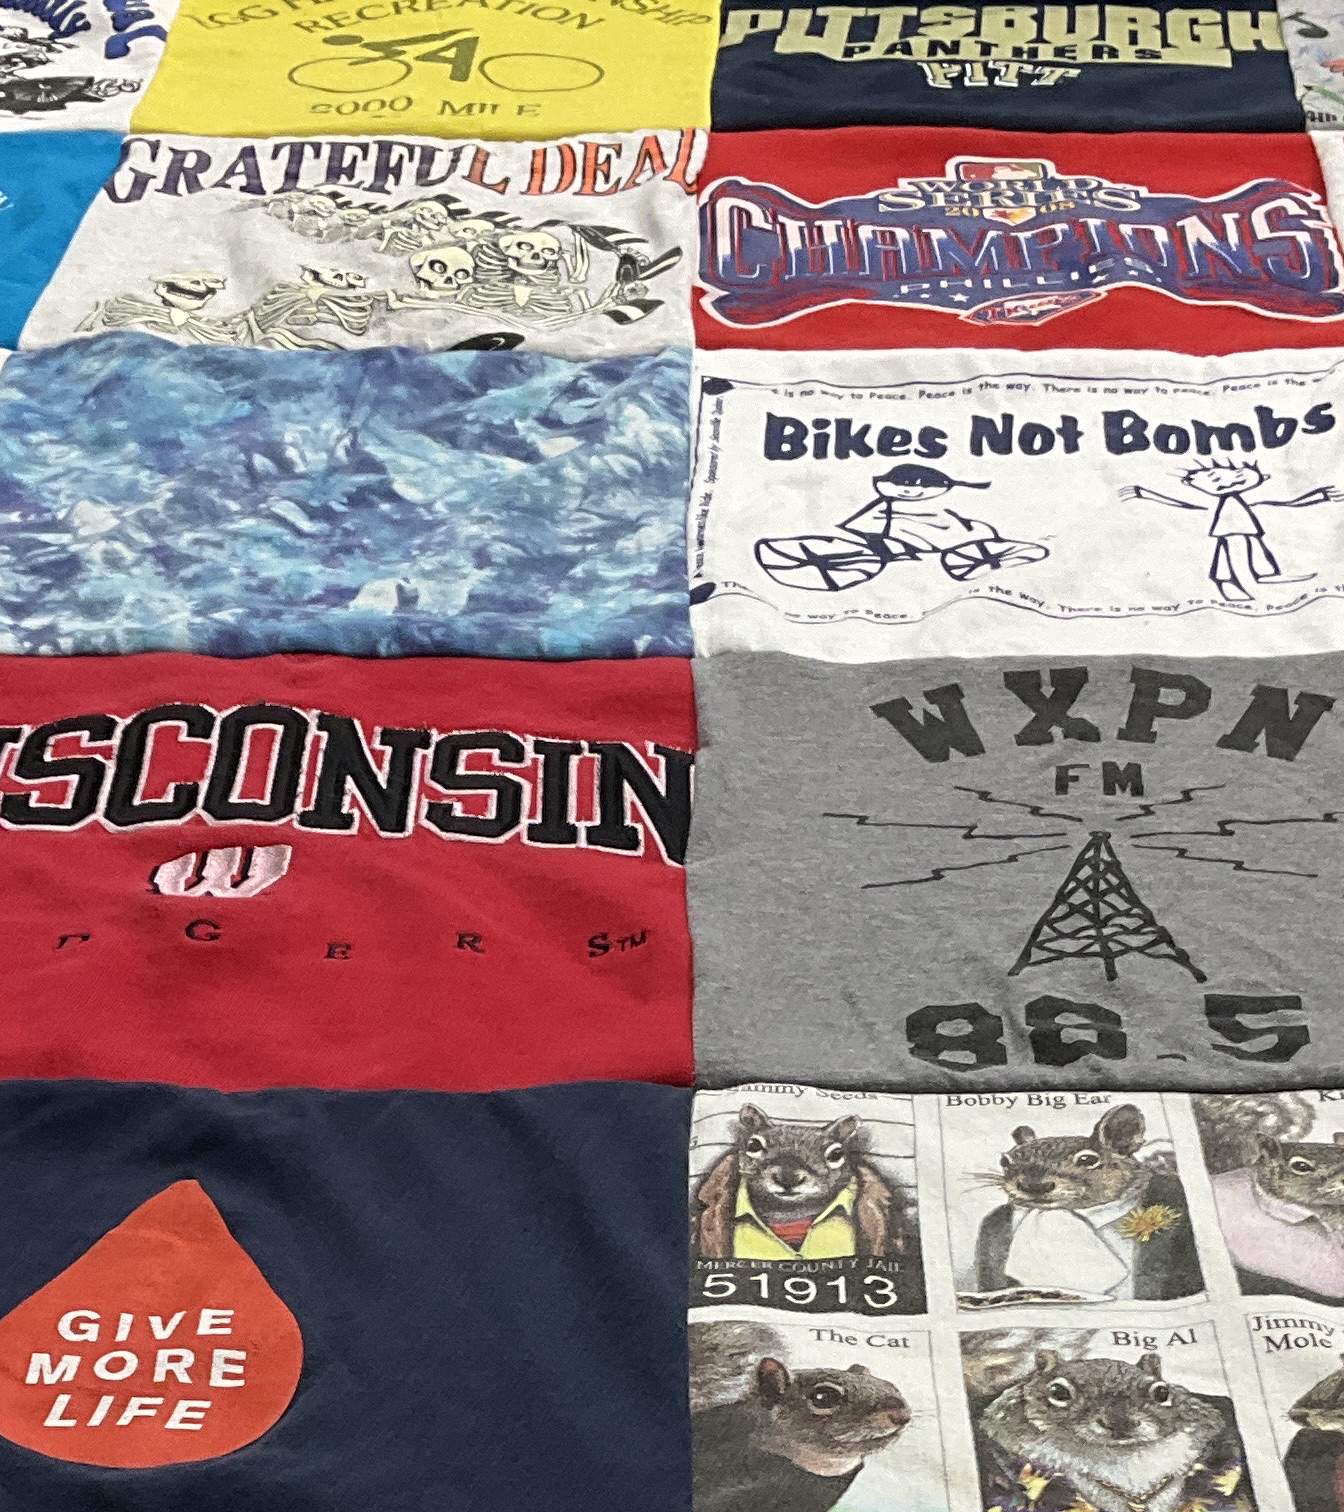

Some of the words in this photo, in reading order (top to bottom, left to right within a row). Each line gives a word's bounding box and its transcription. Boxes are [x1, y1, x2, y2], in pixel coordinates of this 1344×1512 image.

[718, 5, 1288, 66] PITTSBURGH
[841, 40, 1164, 60] PANTHERS
[917, 60, 1082, 89] PITT
[104, 137, 510, 204] GRATEFUL
[908, 177, 1103, 193] WORLD
[877, 187, 1142, 213] SERIES
[709, 192, 1324, 284] CHAMPIONS
[763, 411, 949, 461] Bikes
[969, 412, 1084, 457] Not
[1102, 401, 1337, 456] Bombs
[868, 664, 1339, 763] WXPN
[1054, 760, 1146, 797] FM
[945, 1094, 1018, 1109] Bobby
[1027, 1093, 1067, 1109] Big
[1074, 1092, 1112, 1105] Ear
[777, 1257, 860, 1273] COUNTY
[865, 1258, 905, 1273] JAIL
[701, 1272, 899, 1309] 51913
[56, 1307, 236, 1343] GIVE
[808, 1327, 859, 1348] The
[865, 1333, 911, 1349] Cat
[1111, 1330, 1159, 1352] Big
[1165, 1328, 1199, 1345] Al
[1249, 1314, 1337, 1337] Jimmy
[1261, 1333, 1335, 1354] Mole
[24, 1347, 249, 1389] MORE
[42, 1393, 213, 1431] LIFE
